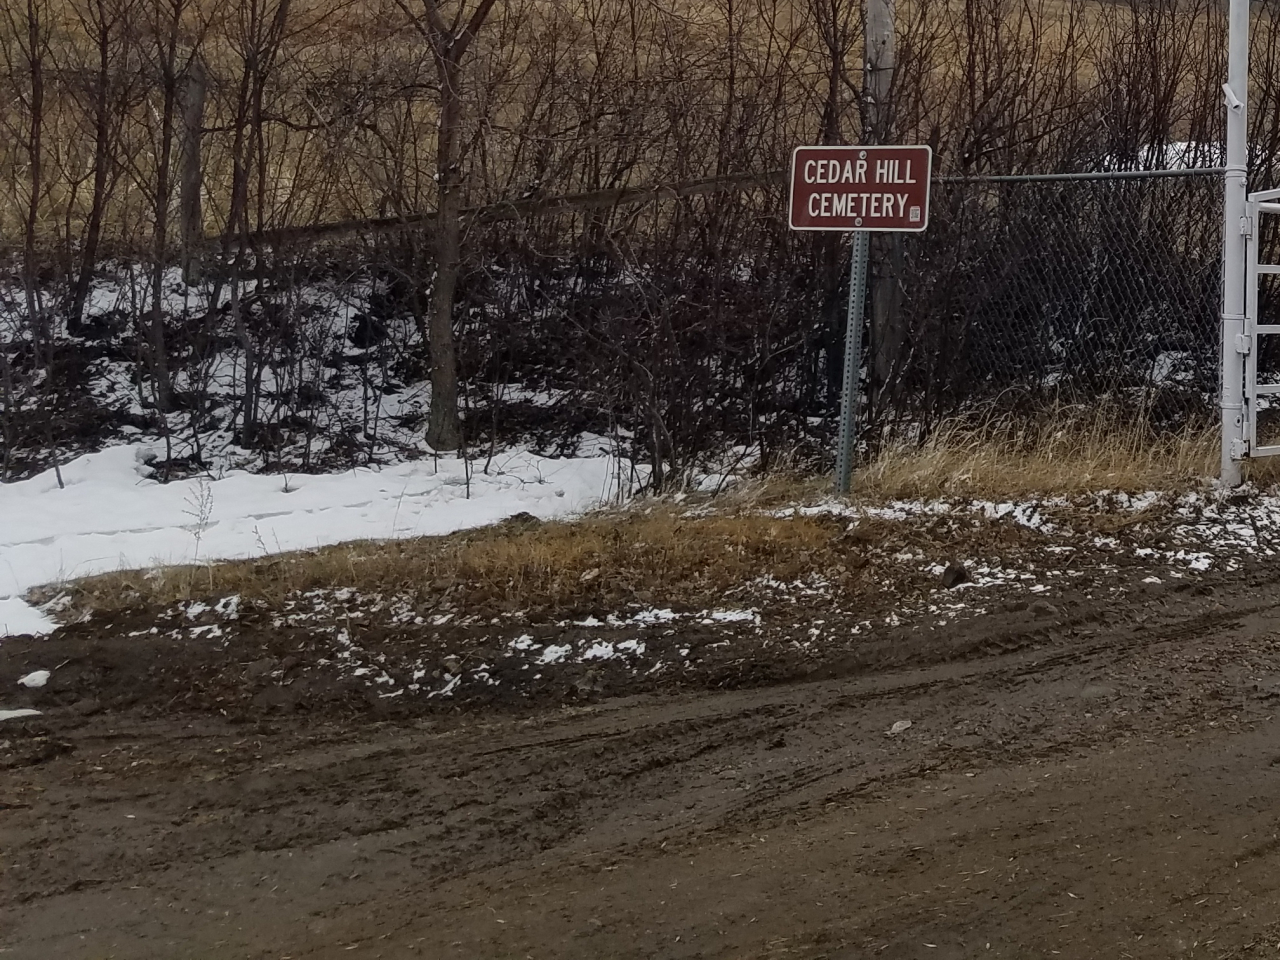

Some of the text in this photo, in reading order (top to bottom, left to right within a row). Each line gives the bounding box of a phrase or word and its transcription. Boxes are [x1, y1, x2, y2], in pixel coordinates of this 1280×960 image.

[804, 159, 917, 184] CEDAR HILL
[808, 192, 909, 218] CEMETERY
